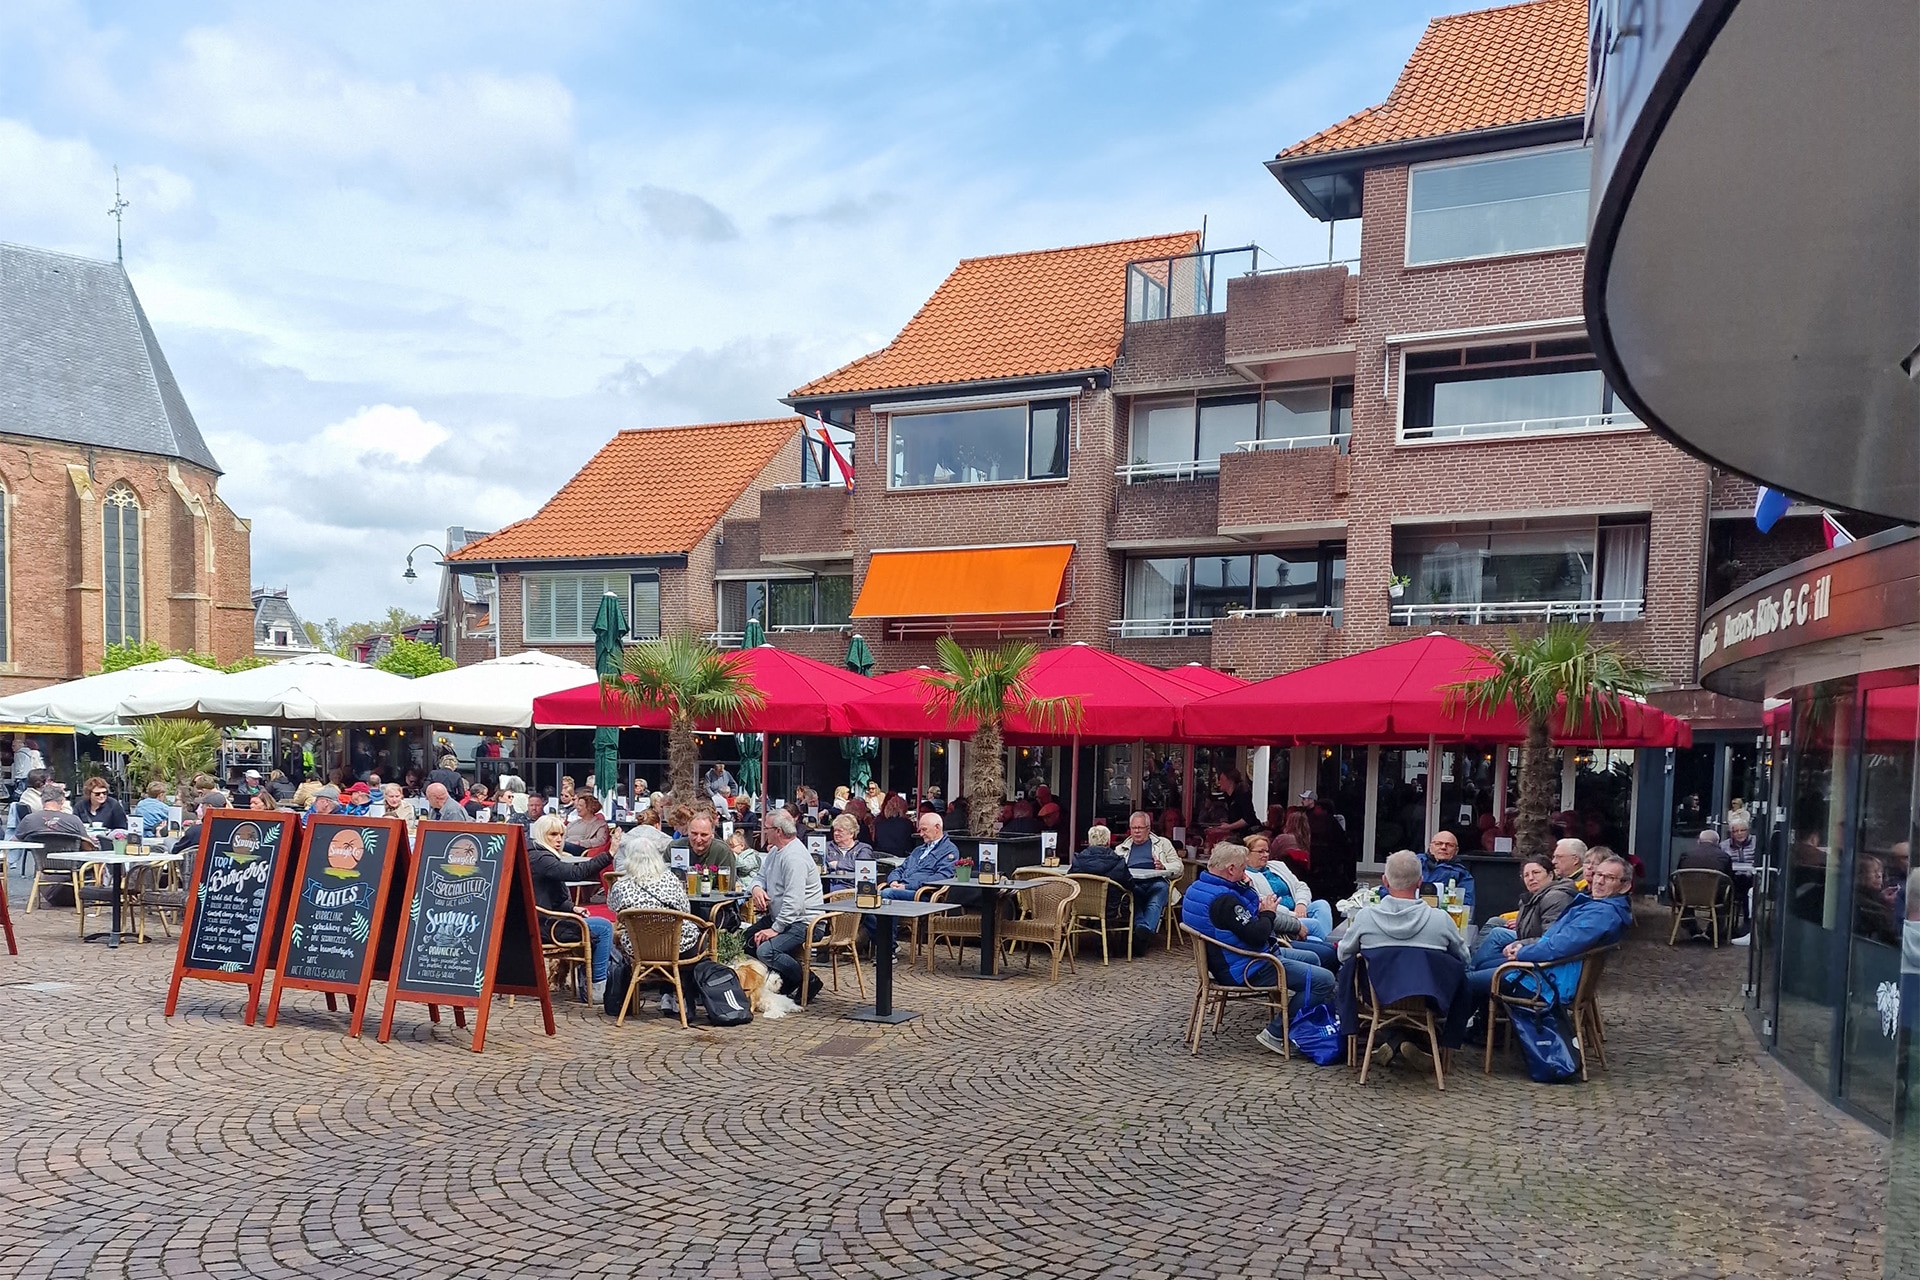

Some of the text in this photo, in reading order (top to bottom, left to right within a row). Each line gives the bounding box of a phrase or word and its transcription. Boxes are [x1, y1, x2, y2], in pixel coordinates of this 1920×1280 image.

[1756, 595, 1781, 637] Ribs
[1781, 588, 1795, 630] &
[233, 835, 261, 852] Sunny's
[209, 861, 269, 893] Burgers
[315, 887, 359, 906] PLATES
[436, 880, 483, 896] SPECIALITEIT
[315, 910, 344, 922] KIBBELING
[425, 908, 481, 938] Sunny's
